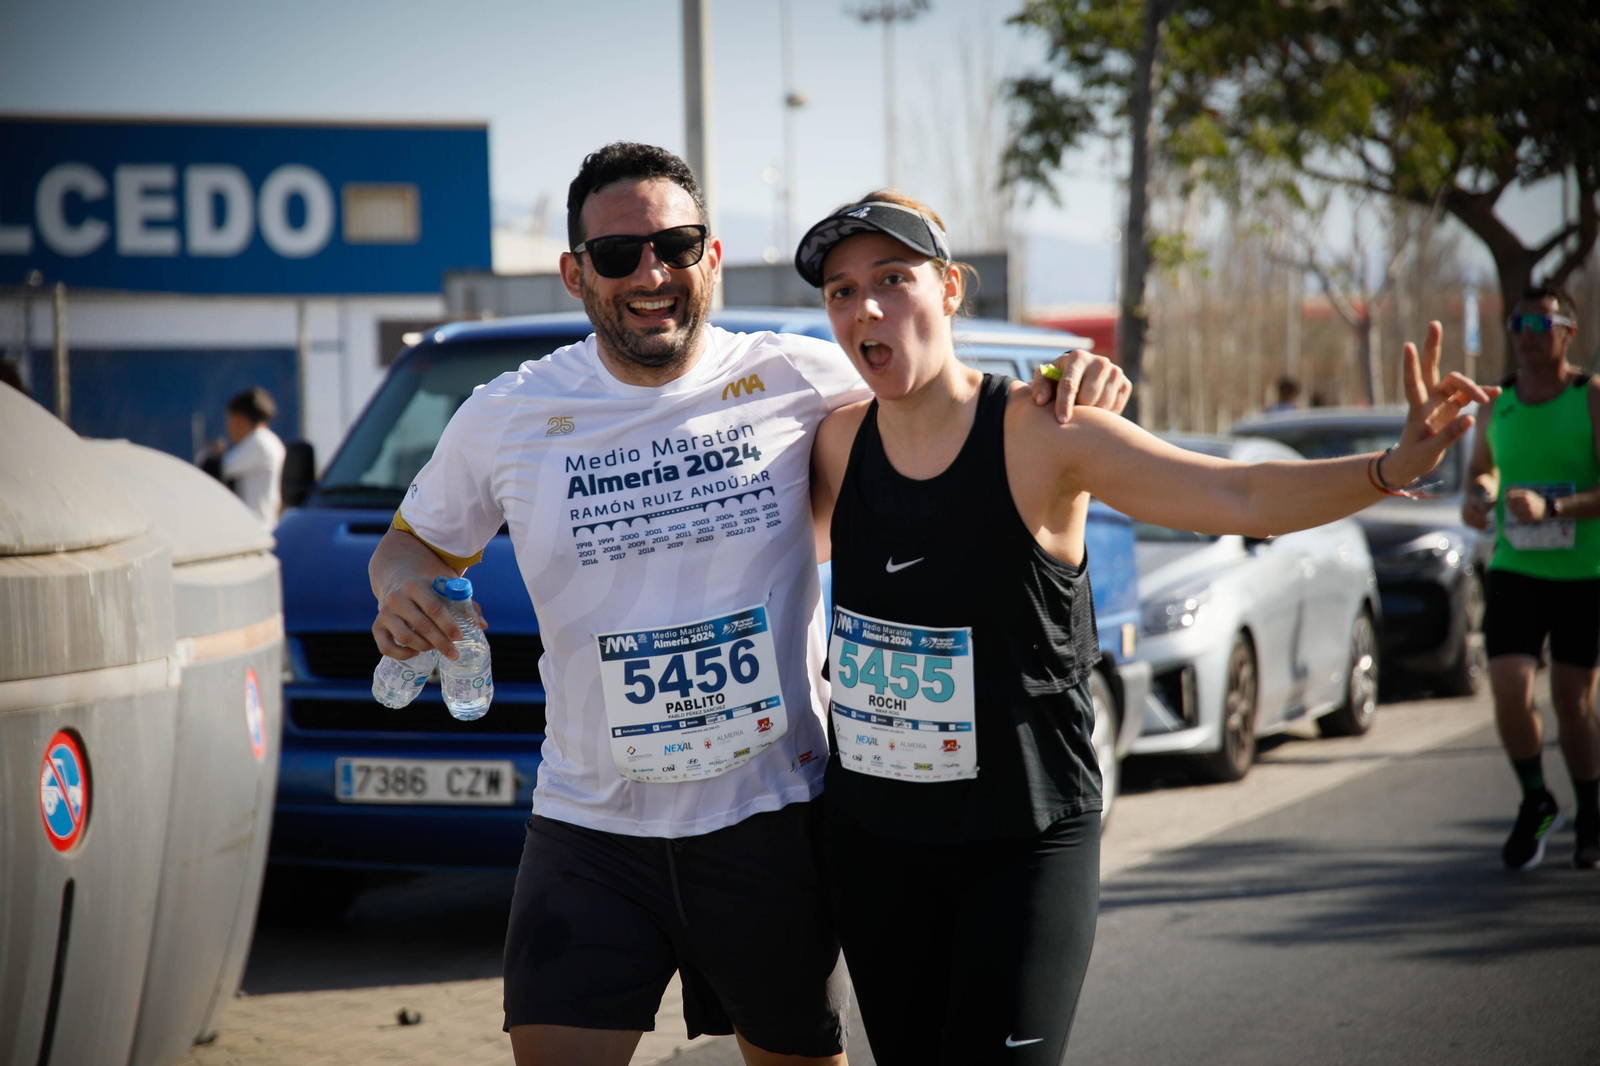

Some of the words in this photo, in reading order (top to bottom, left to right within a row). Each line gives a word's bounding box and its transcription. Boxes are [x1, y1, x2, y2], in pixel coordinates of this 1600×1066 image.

[546, 416, 576, 435] 25
[565, 447, 641, 473] Medio
[651, 424, 755, 458] Maratón
[567, 460, 680, 499] Almería
[684, 442, 762, 477] 2024
[570, 500, 635, 521] RAMÓN
[642, 490, 684, 508] RUIZ
[690, 470, 770, 498] ANDÚJAR
[575, 541, 593, 550] 1998
[598, 537, 614, 546] 1999
[620, 532, 640, 542] 2000
[644, 528, 662, 536] 2001
[668, 523, 686, 532] 2002
[692, 518, 710, 527] 2003
[715, 513, 734, 522] 2004
[739, 507, 758, 516] 2005
[762, 502, 778, 511] 2006
[578, 550, 596, 558] 2007
[602, 544, 622, 554] 2008
[627, 540, 646, 549] 2009
[652, 536, 670, 544] 2010
[676, 531, 692, 539] 2011
[697, 526, 714, 534] 2012
[720, 520, 738, 530] 2013
[744, 516, 760, 524] 2014
[764, 510, 780, 519] 2015
[581, 558, 598, 566] 2016
[609, 552, 626, 561] 2017
[638, 547, 656, 556] 2018
[667, 541, 684, 550] 2019
[695, 535, 714, 544] 2020
[726, 526, 756, 538] 2022/23
[766, 518, 781, 528] 2024
[652, 630, 678, 640] Medio
[680, 623, 714, 637] Maratón
[654, 634, 690, 649] Almería
[690, 630, 716, 644] 2024
[862, 622, 881, 634] Medio
[882, 626, 912, 638] Maratón
[862, 629, 890, 643] Almería
[890, 636, 913, 647] 2024
[624, 638, 760, 705] 5456
[838, 640, 955, 703] 5455
[665, 693, 726, 714] PABLITO
[868, 694, 907, 712] ROCHI
[664, 741, 693, 756] NEXAL
[716, 729, 744, 742] ALMERÍA
[856, 734, 878, 746] NEXAL
[354, 764, 427, 797] 7386
[446, 766, 502, 797] CZW
